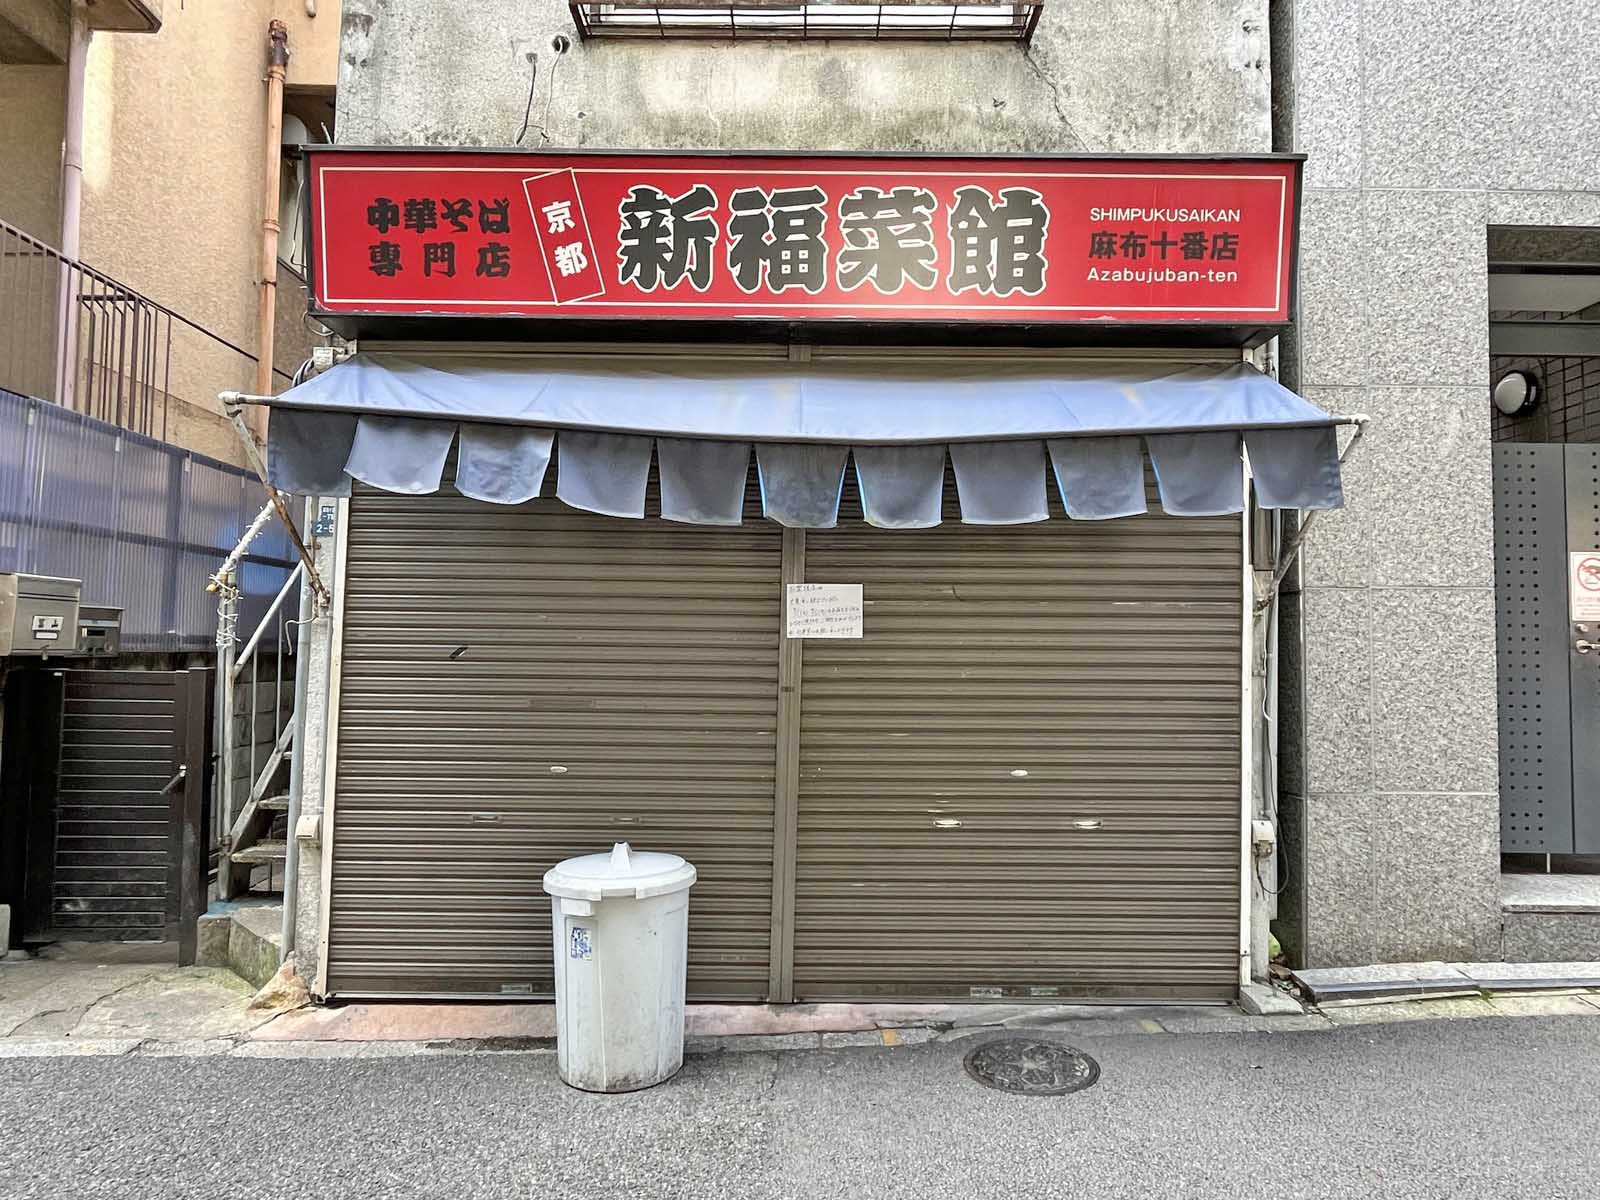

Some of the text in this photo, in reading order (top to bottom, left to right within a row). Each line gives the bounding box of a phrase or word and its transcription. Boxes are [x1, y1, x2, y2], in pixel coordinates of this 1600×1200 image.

[367, 197, 511, 234] 中華そば
[1089, 207, 1241, 222] SHIMPUKUSAIKAN
[541, 200, 588, 277] 京都
[616, 184, 1051, 297] 新福菜館
[1088, 230, 1239, 260] 麻布十番店
[368, 241, 511, 278] 専門店
[1087, 267, 1238, 283] Azabujuban-ten
